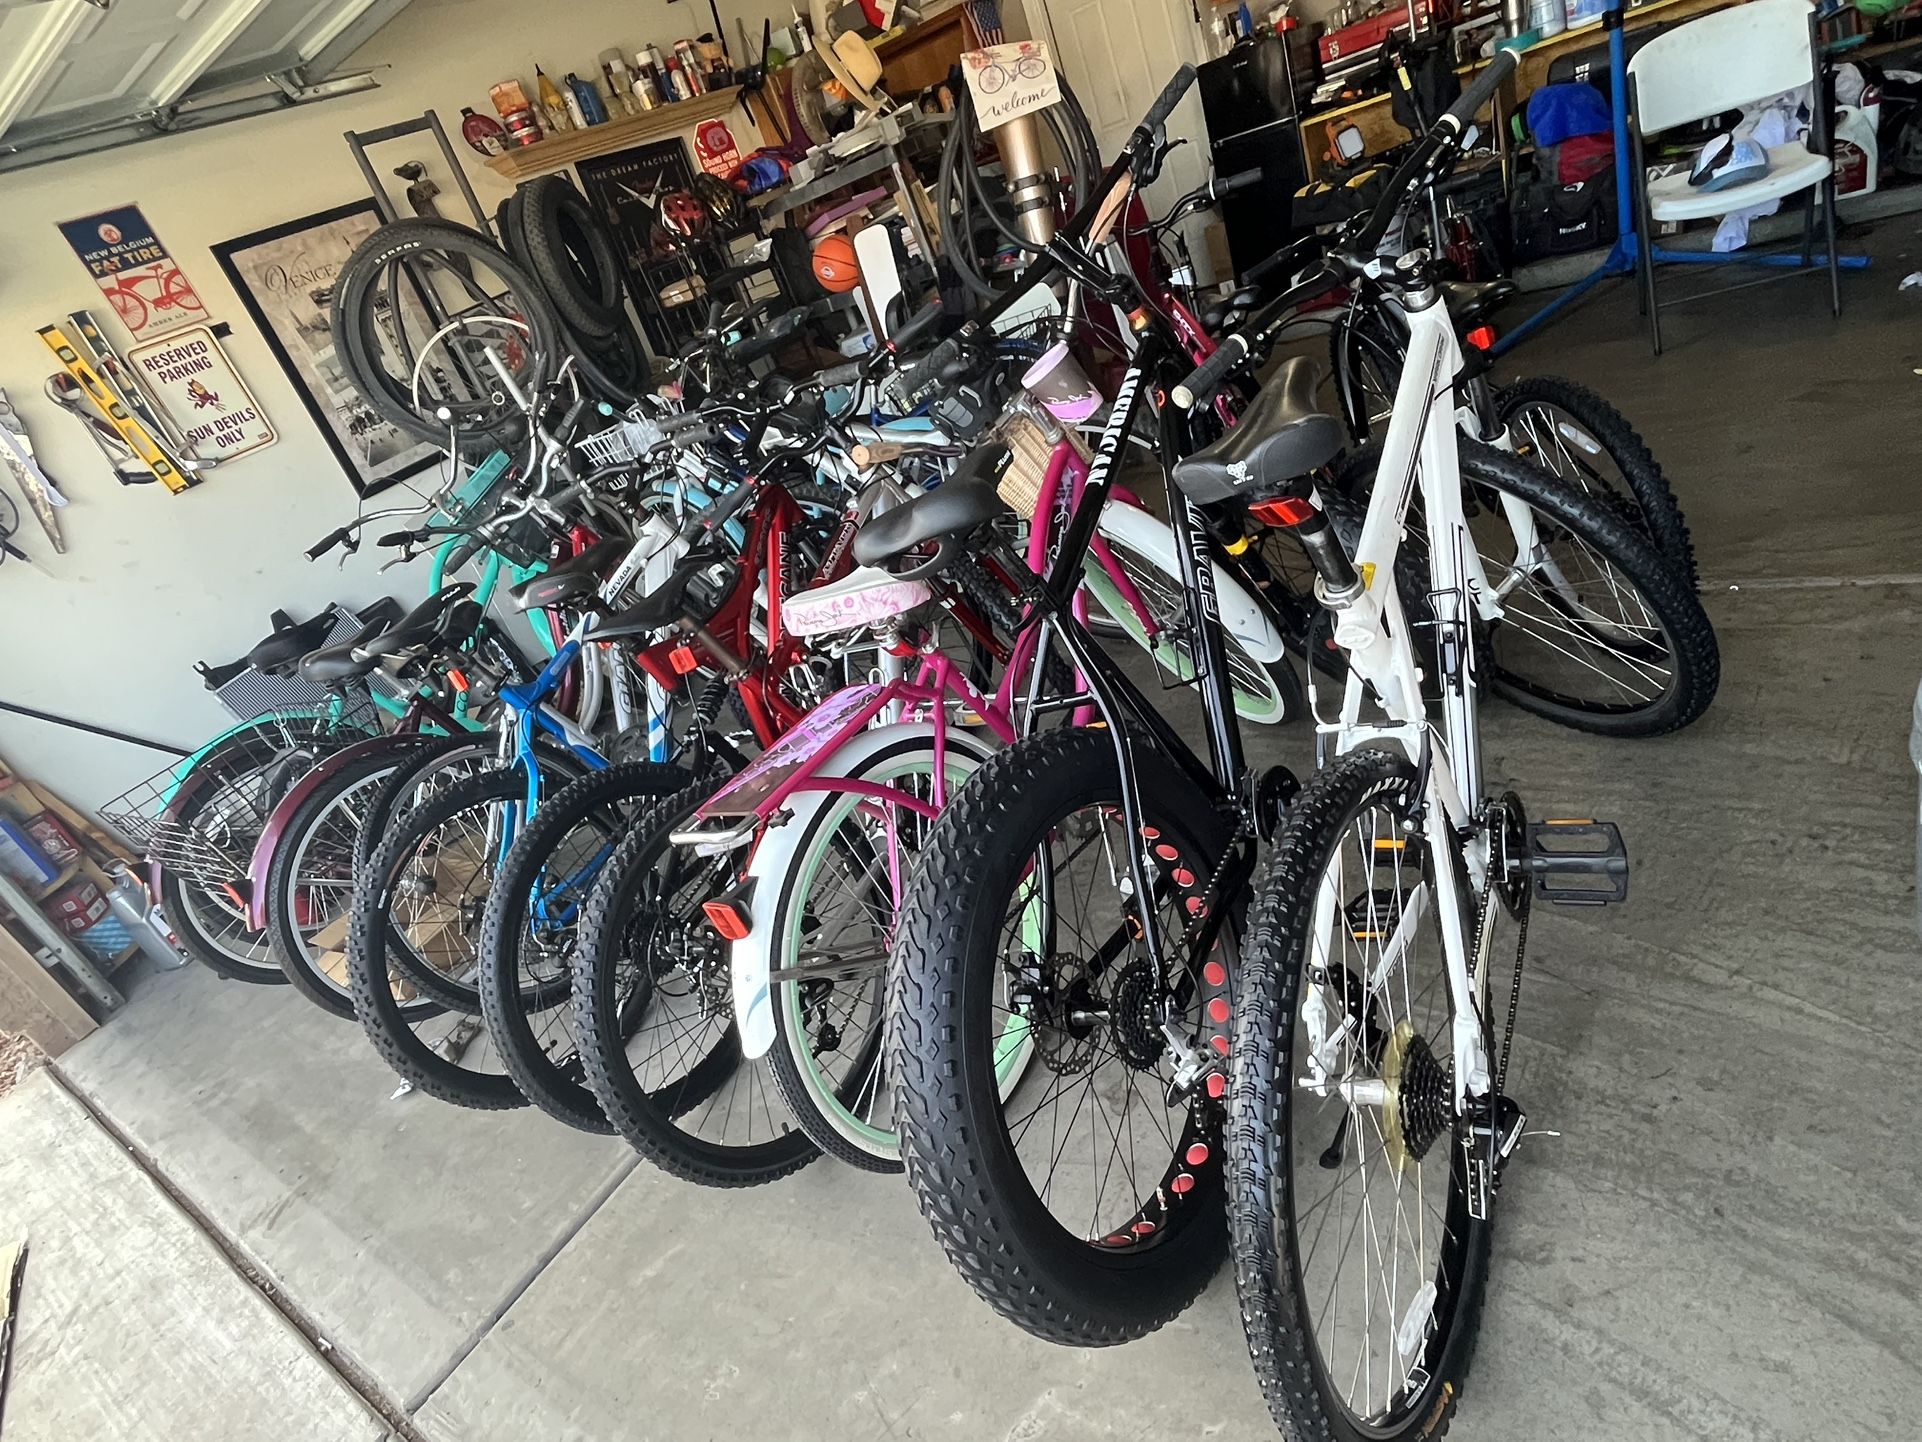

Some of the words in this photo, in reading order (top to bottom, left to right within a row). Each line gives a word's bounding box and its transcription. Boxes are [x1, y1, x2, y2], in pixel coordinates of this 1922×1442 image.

[980, 86, 1056, 119] welcome
[591, 171, 607, 181] THE
[610, 163, 639, 176] DREAM
[642, 153, 678, 168] FACTORY
[84, 245, 109, 262] NEW
[110, 236, 155, 254] BELGIUM
[90, 258, 122, 275] FAT
[125, 246, 163, 265] TIRE
[264, 252, 337, 296] VENICE
[148, 316, 173, 329] AMBER
[174, 312, 189, 320] ALE
[142, 340, 208, 372] RESERVED
[158, 356, 213, 384] PARKING
[186, 424, 215, 443] SUN
[213, 407, 256, 432] DEVILS
[215, 427, 245, 448] ONLY
[608, 565, 632, 597] NEVADA
